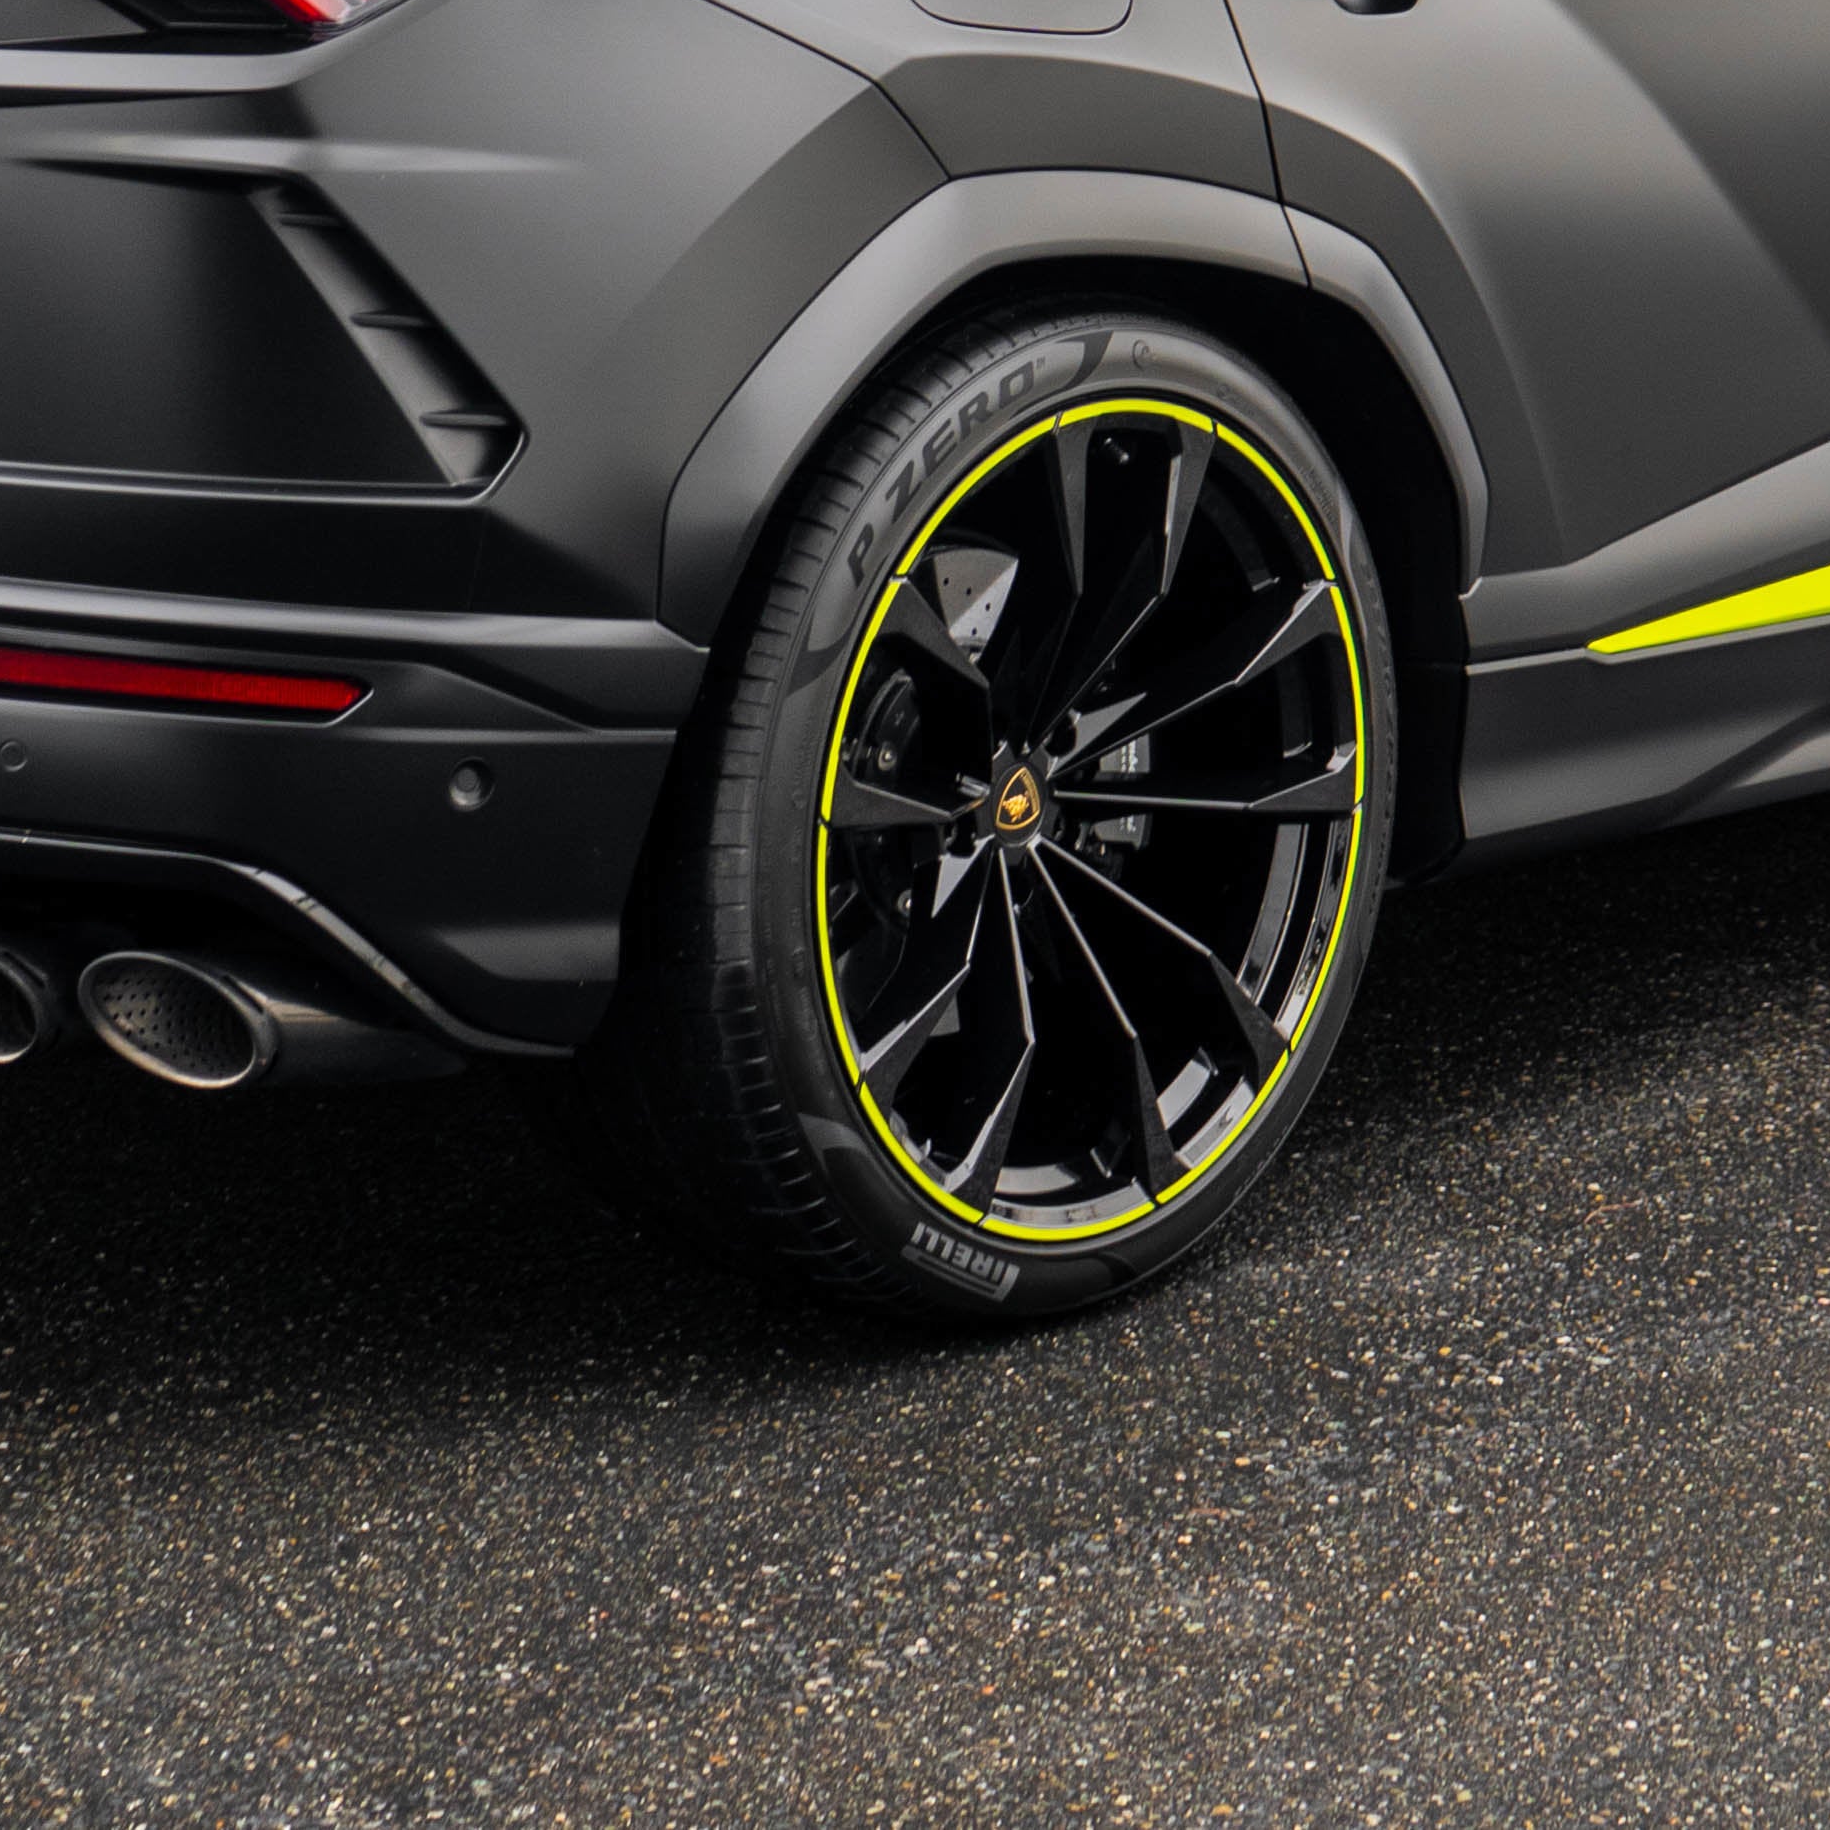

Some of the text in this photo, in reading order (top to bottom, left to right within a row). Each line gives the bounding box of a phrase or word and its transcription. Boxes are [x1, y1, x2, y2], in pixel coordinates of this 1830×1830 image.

[847, 360, 1035, 589] P ZERO
[901, 1220, 1021, 1302] PIRELLI
